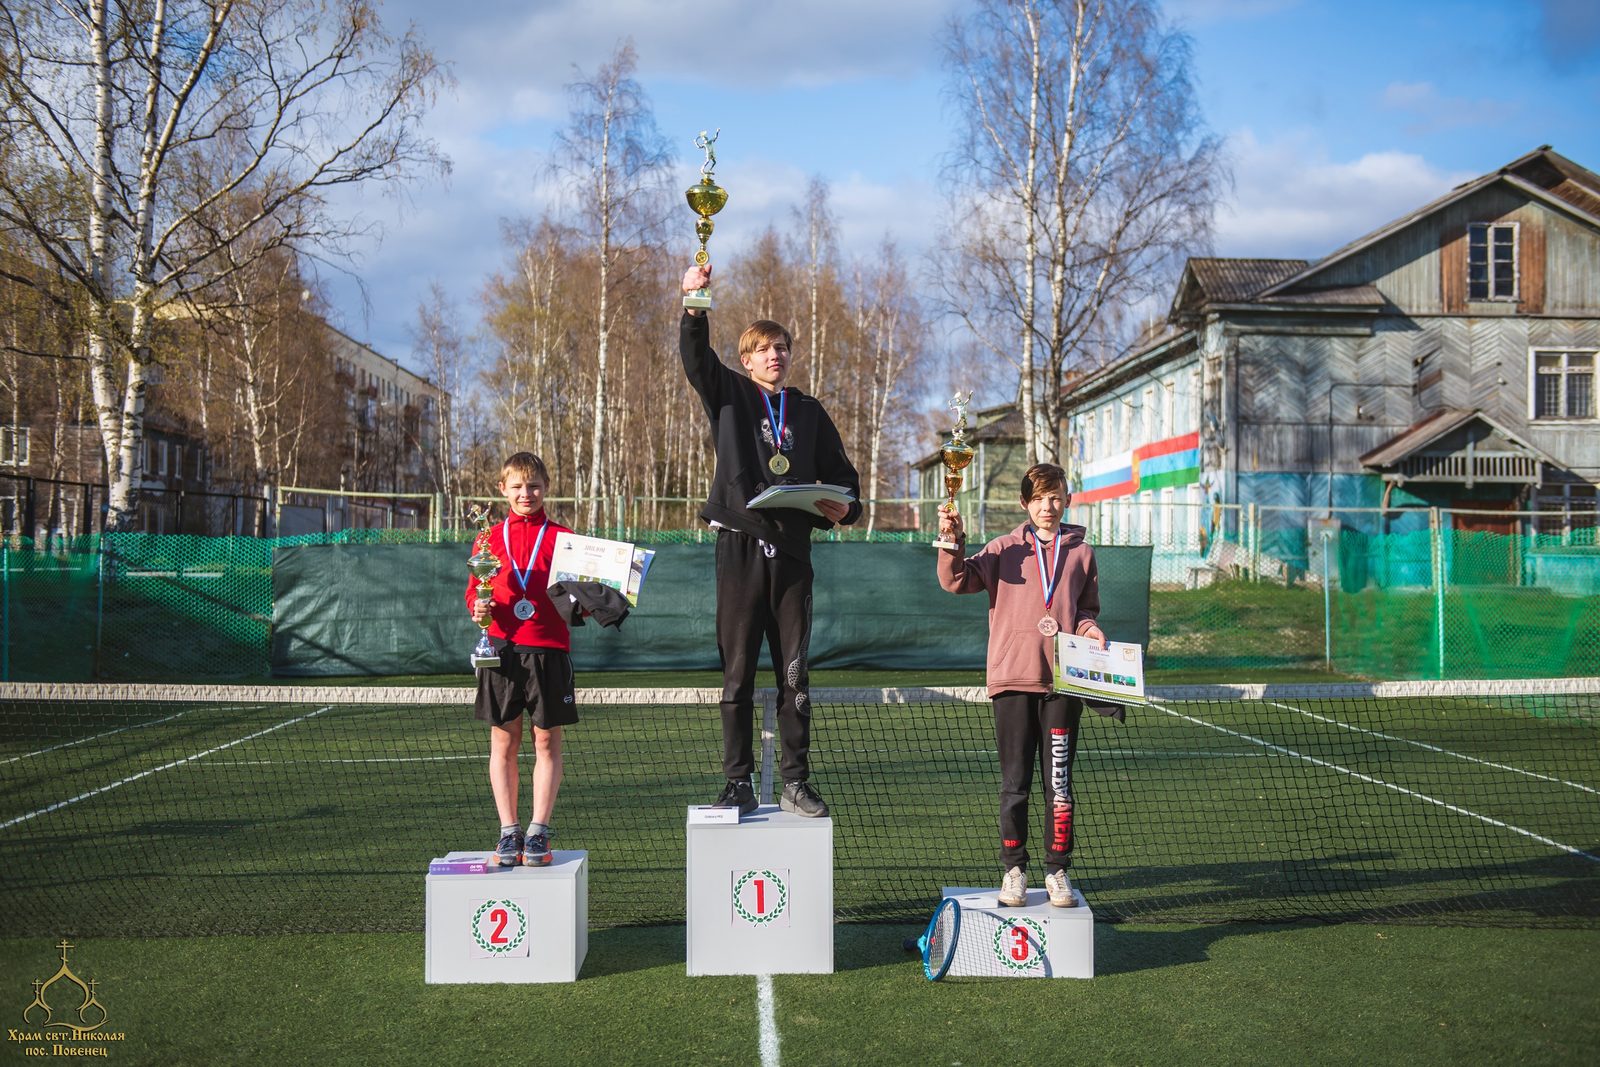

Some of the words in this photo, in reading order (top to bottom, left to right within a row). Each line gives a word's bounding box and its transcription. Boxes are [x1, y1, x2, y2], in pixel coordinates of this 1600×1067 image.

[754, 880, 764, 913] 1
[491, 909, 508, 943] 2
[1011, 926, 1028, 960] 3
